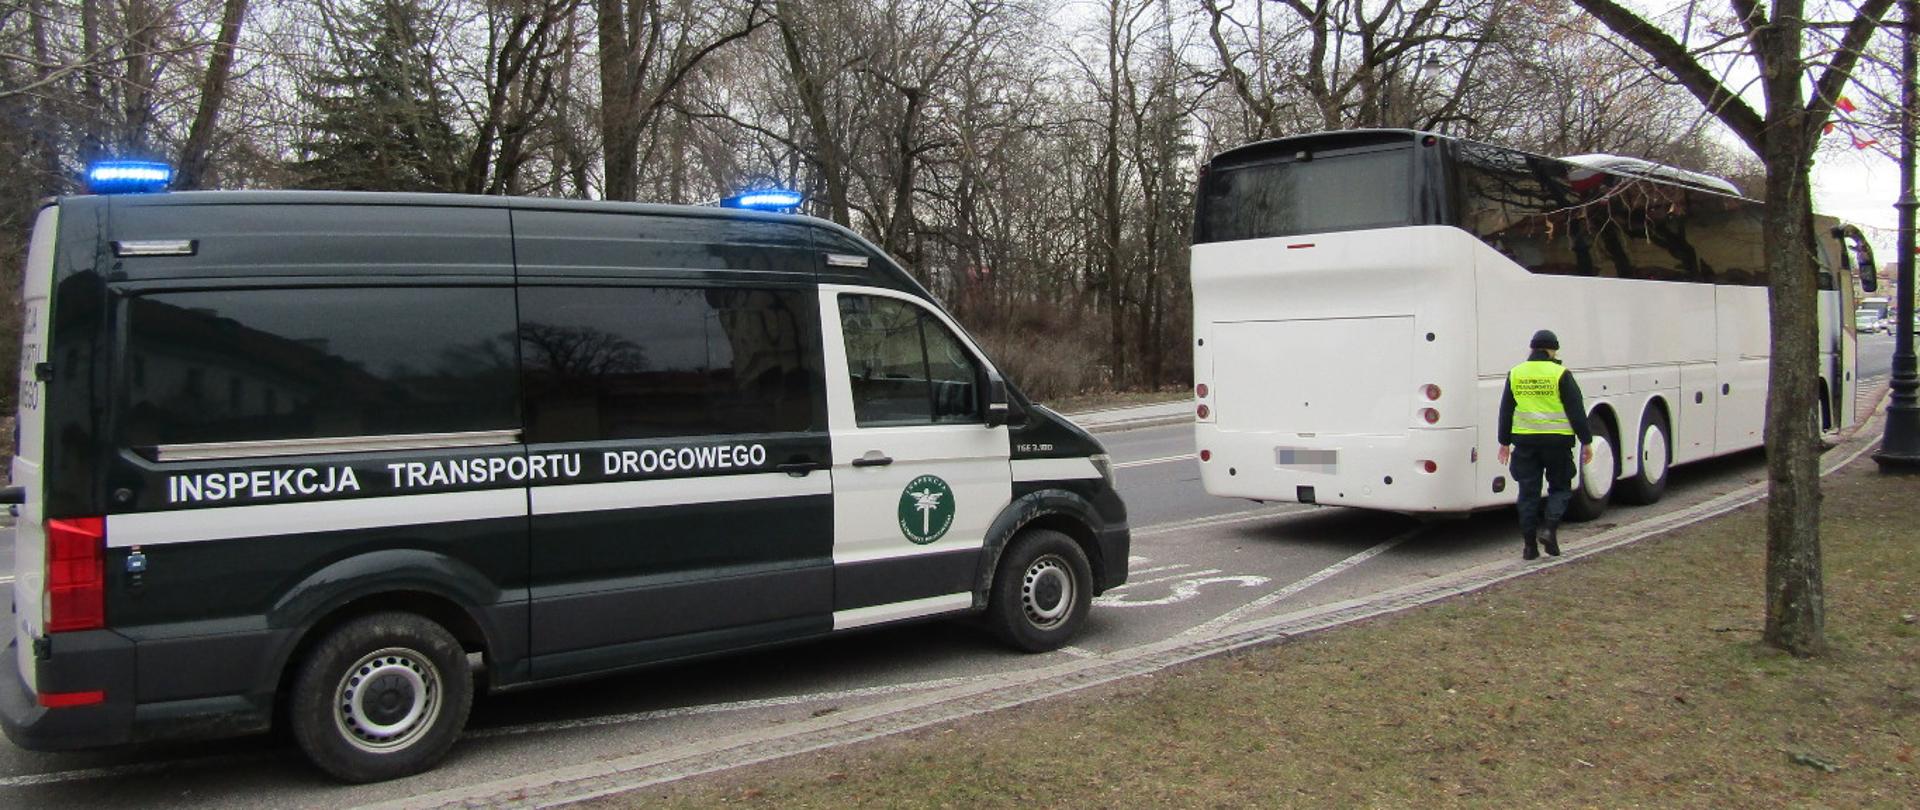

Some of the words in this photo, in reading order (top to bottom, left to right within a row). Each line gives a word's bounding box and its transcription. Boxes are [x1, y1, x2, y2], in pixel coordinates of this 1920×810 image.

[169, 466, 361, 503] INSPEKCJA
[387, 453, 582, 489] TRANSPORTU
[603, 444, 766, 475] DROGOWEGO
